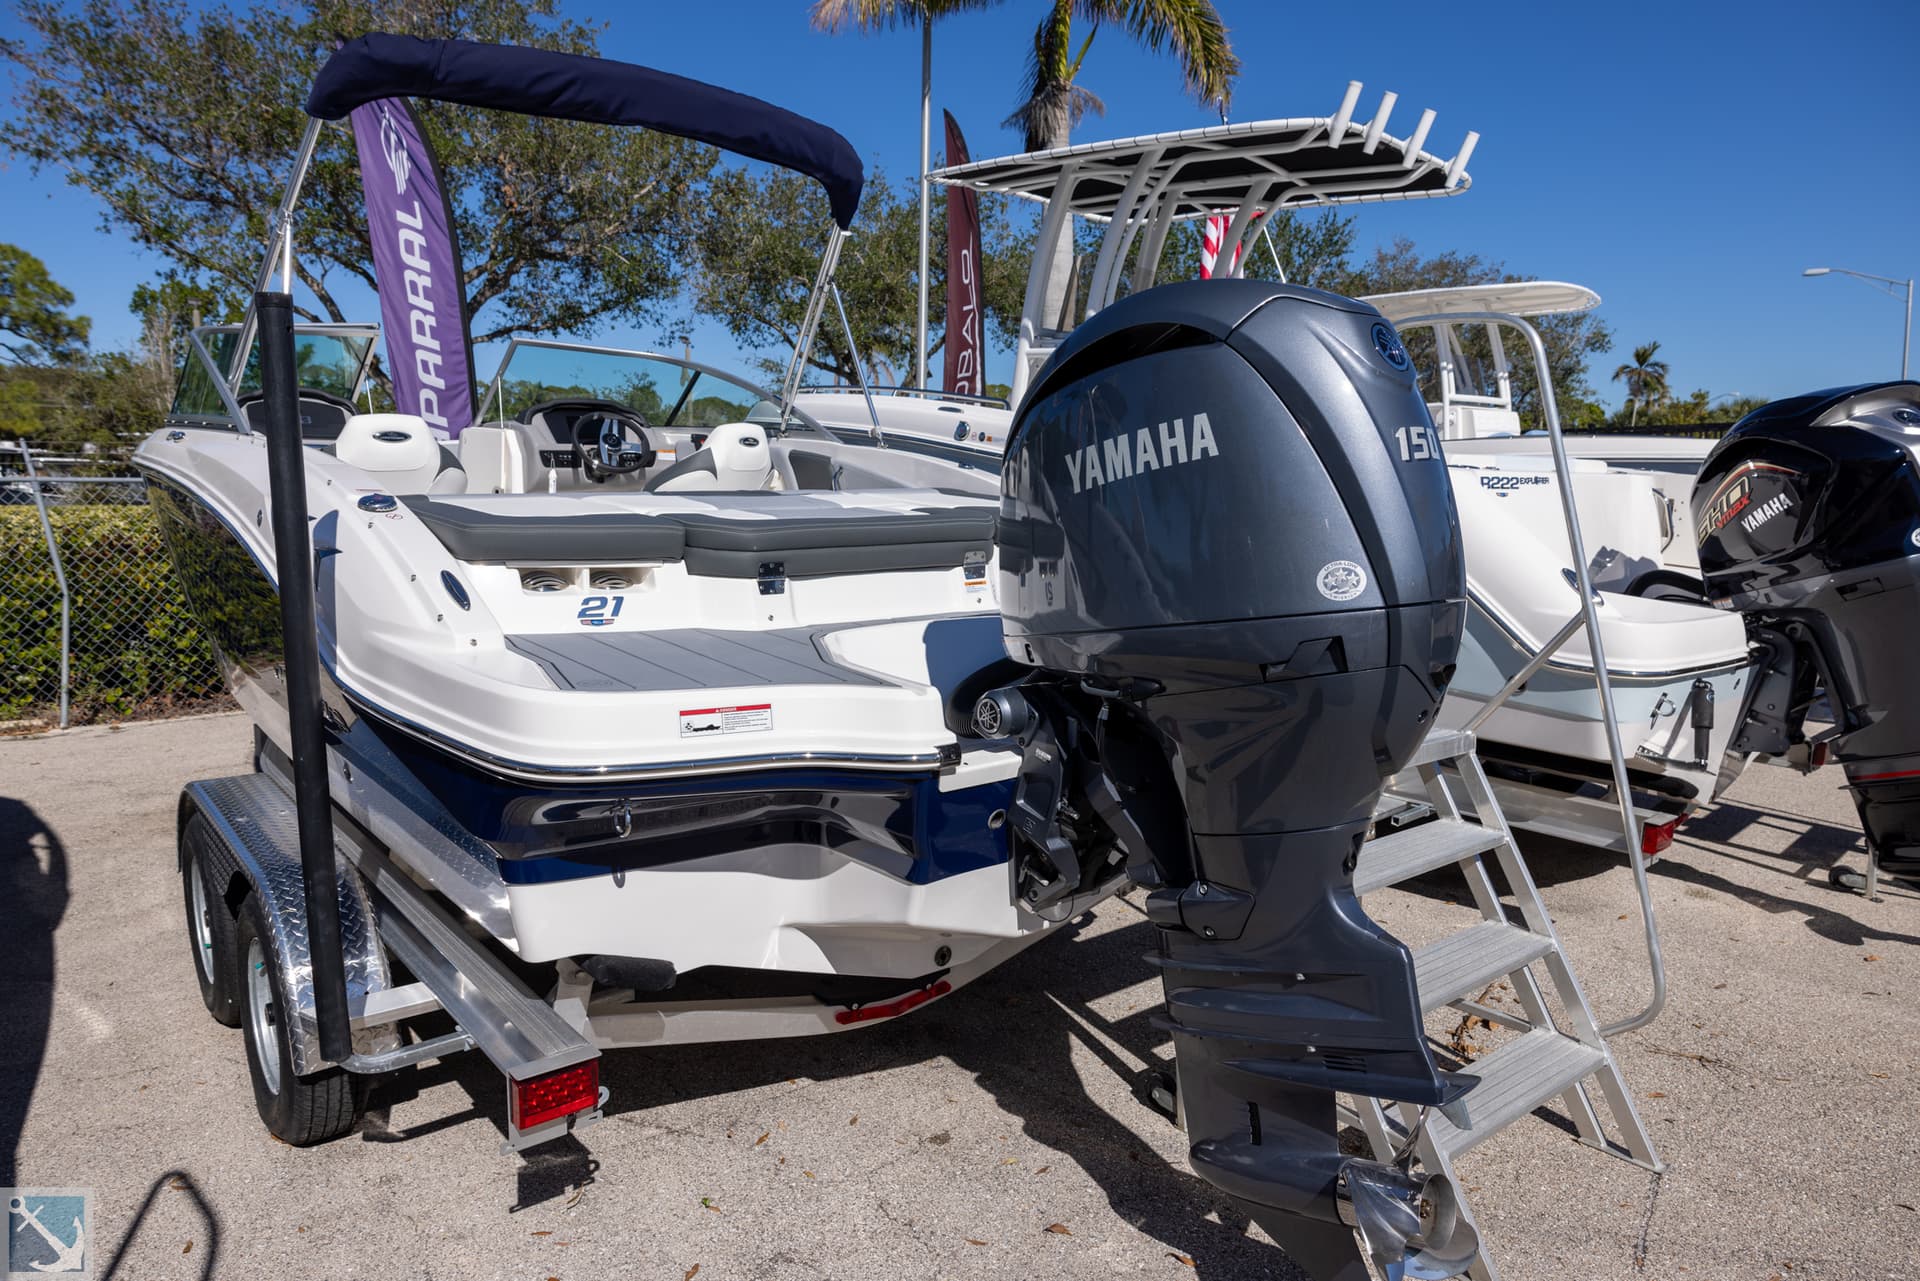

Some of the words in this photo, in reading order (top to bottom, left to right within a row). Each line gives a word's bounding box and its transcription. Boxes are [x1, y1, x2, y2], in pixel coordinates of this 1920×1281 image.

[1065, 412, 1219, 494] YAMAHA
[1395, 426, 1441, 461] 150
[1480, 476, 1519, 489] R222
[1741, 492, 1794, 533] YAMAHA
[577, 596, 624, 618] 21
